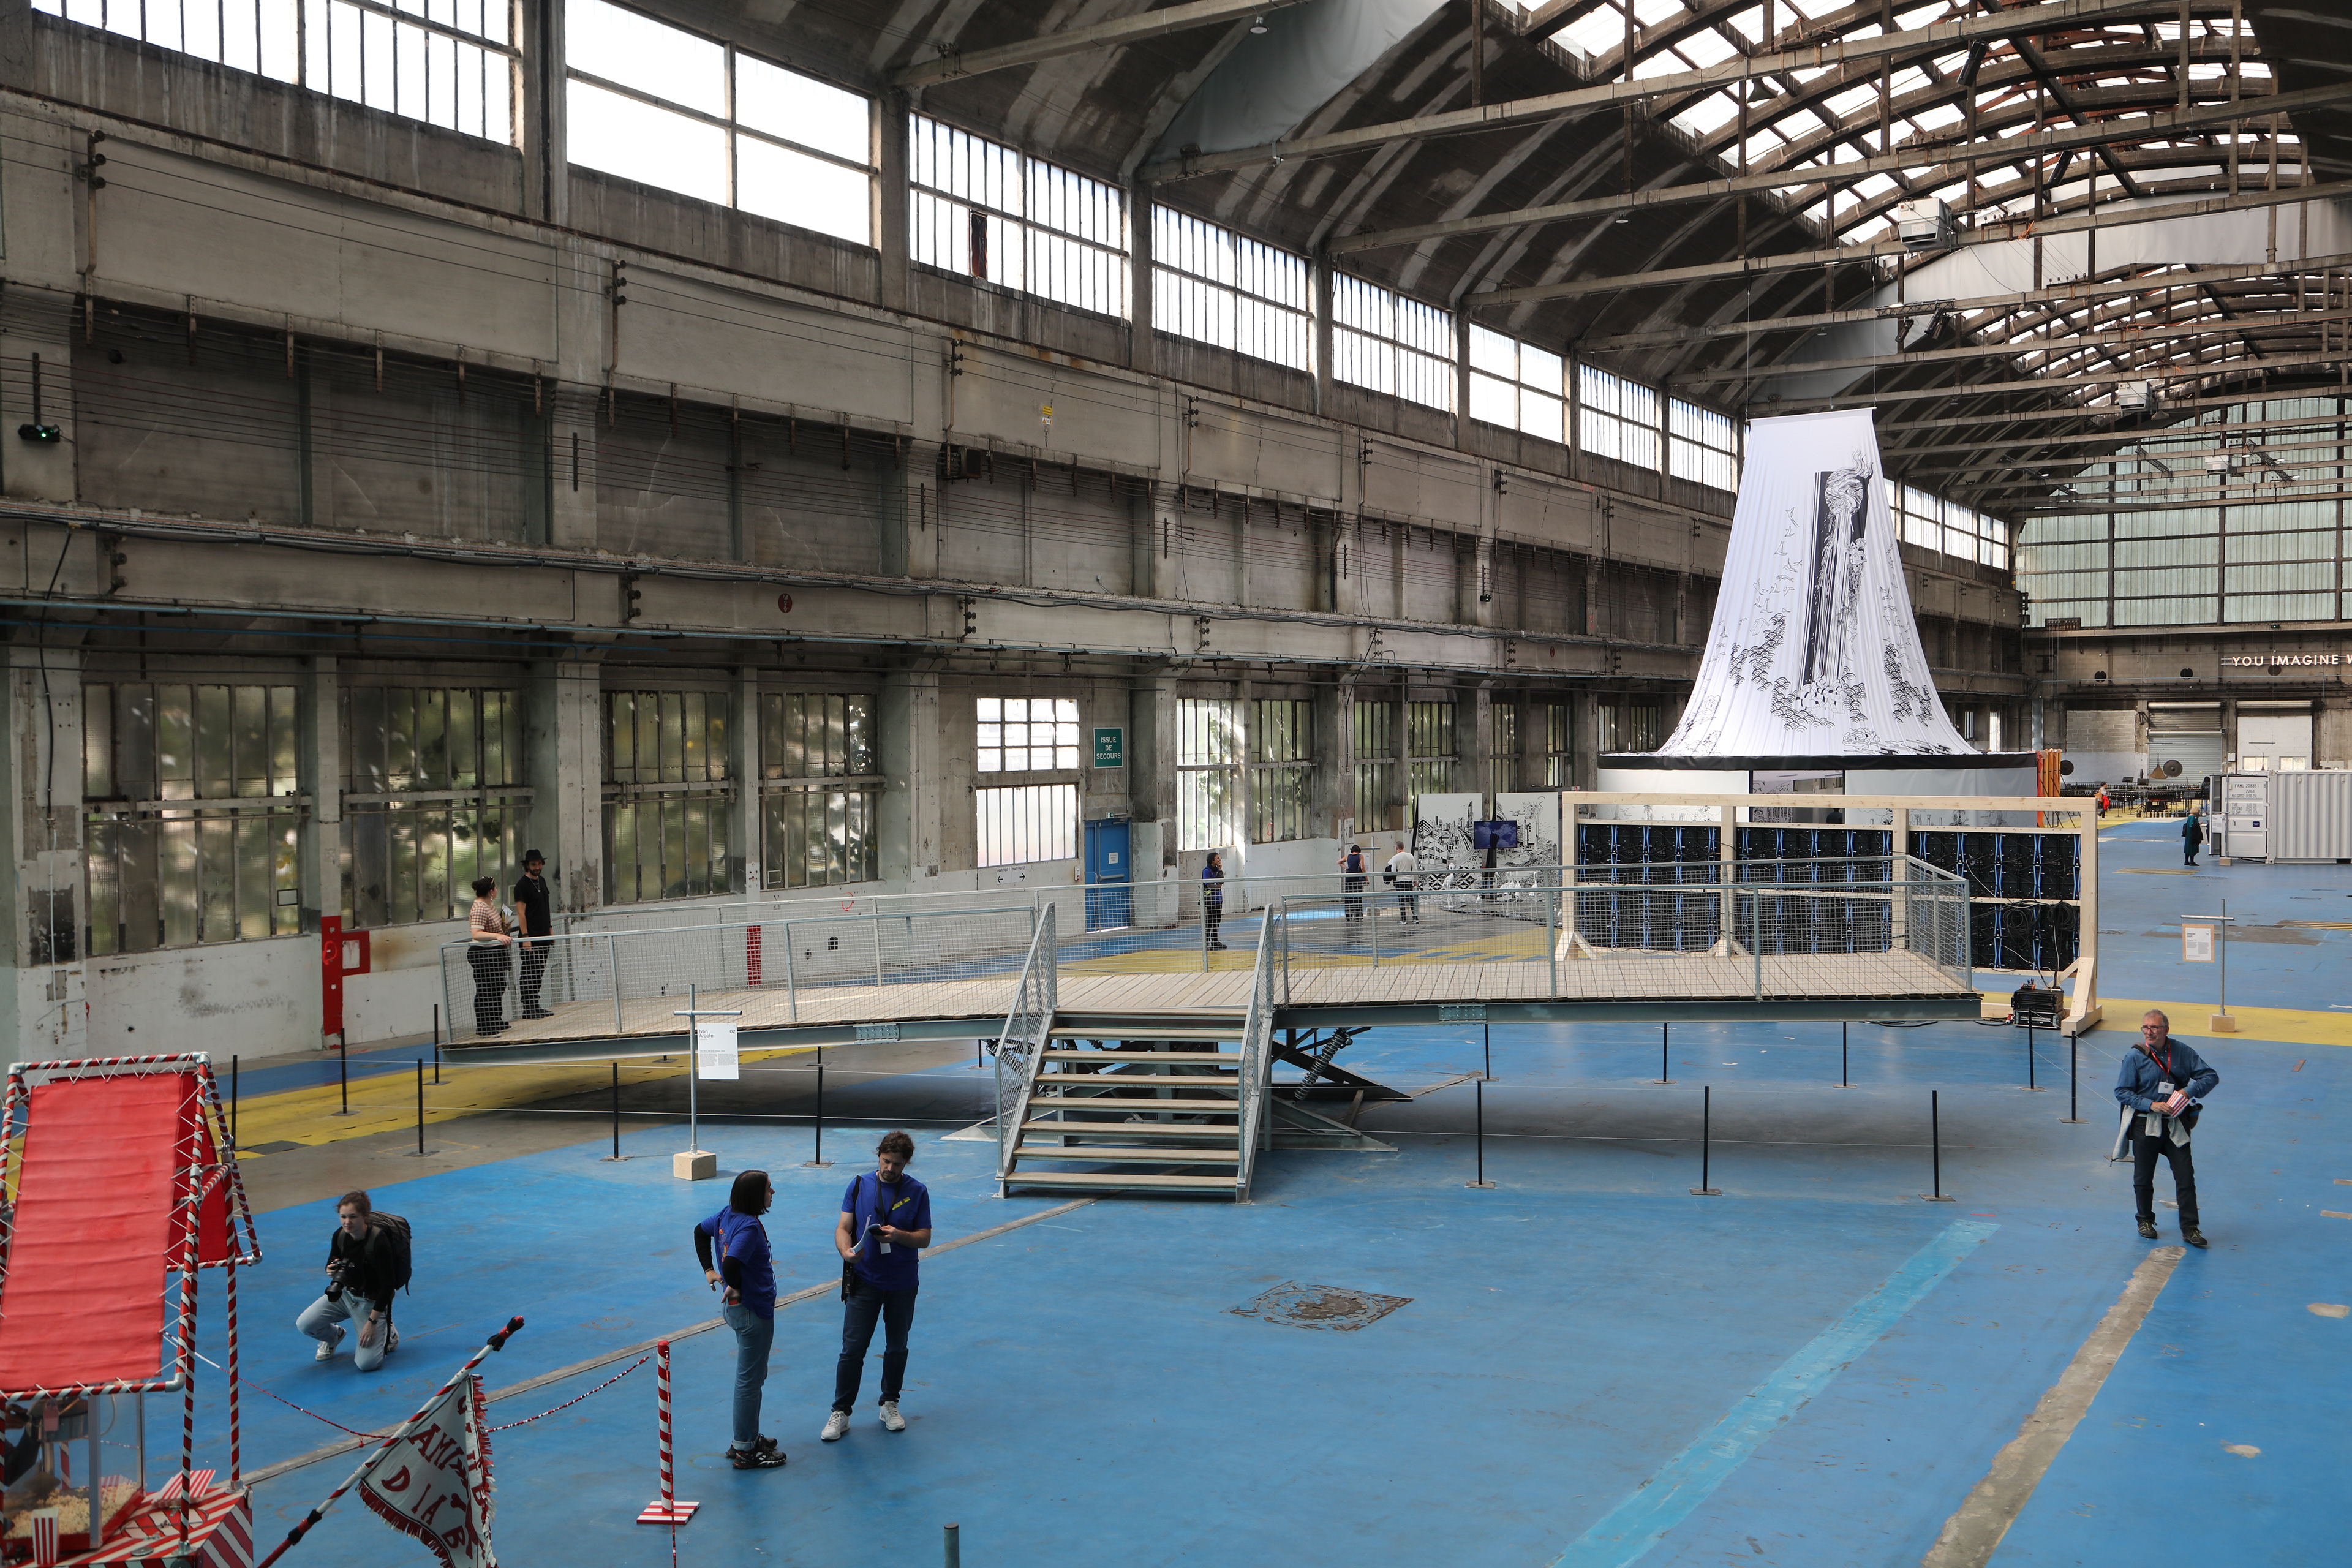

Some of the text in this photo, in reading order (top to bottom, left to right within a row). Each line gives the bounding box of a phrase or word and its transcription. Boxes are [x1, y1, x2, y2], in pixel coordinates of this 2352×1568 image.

[2232, 655, 2264, 666] YOU
[2271, 654, 2339, 666] IMAGINE
[381, 1465, 470, 1568] DIAB
